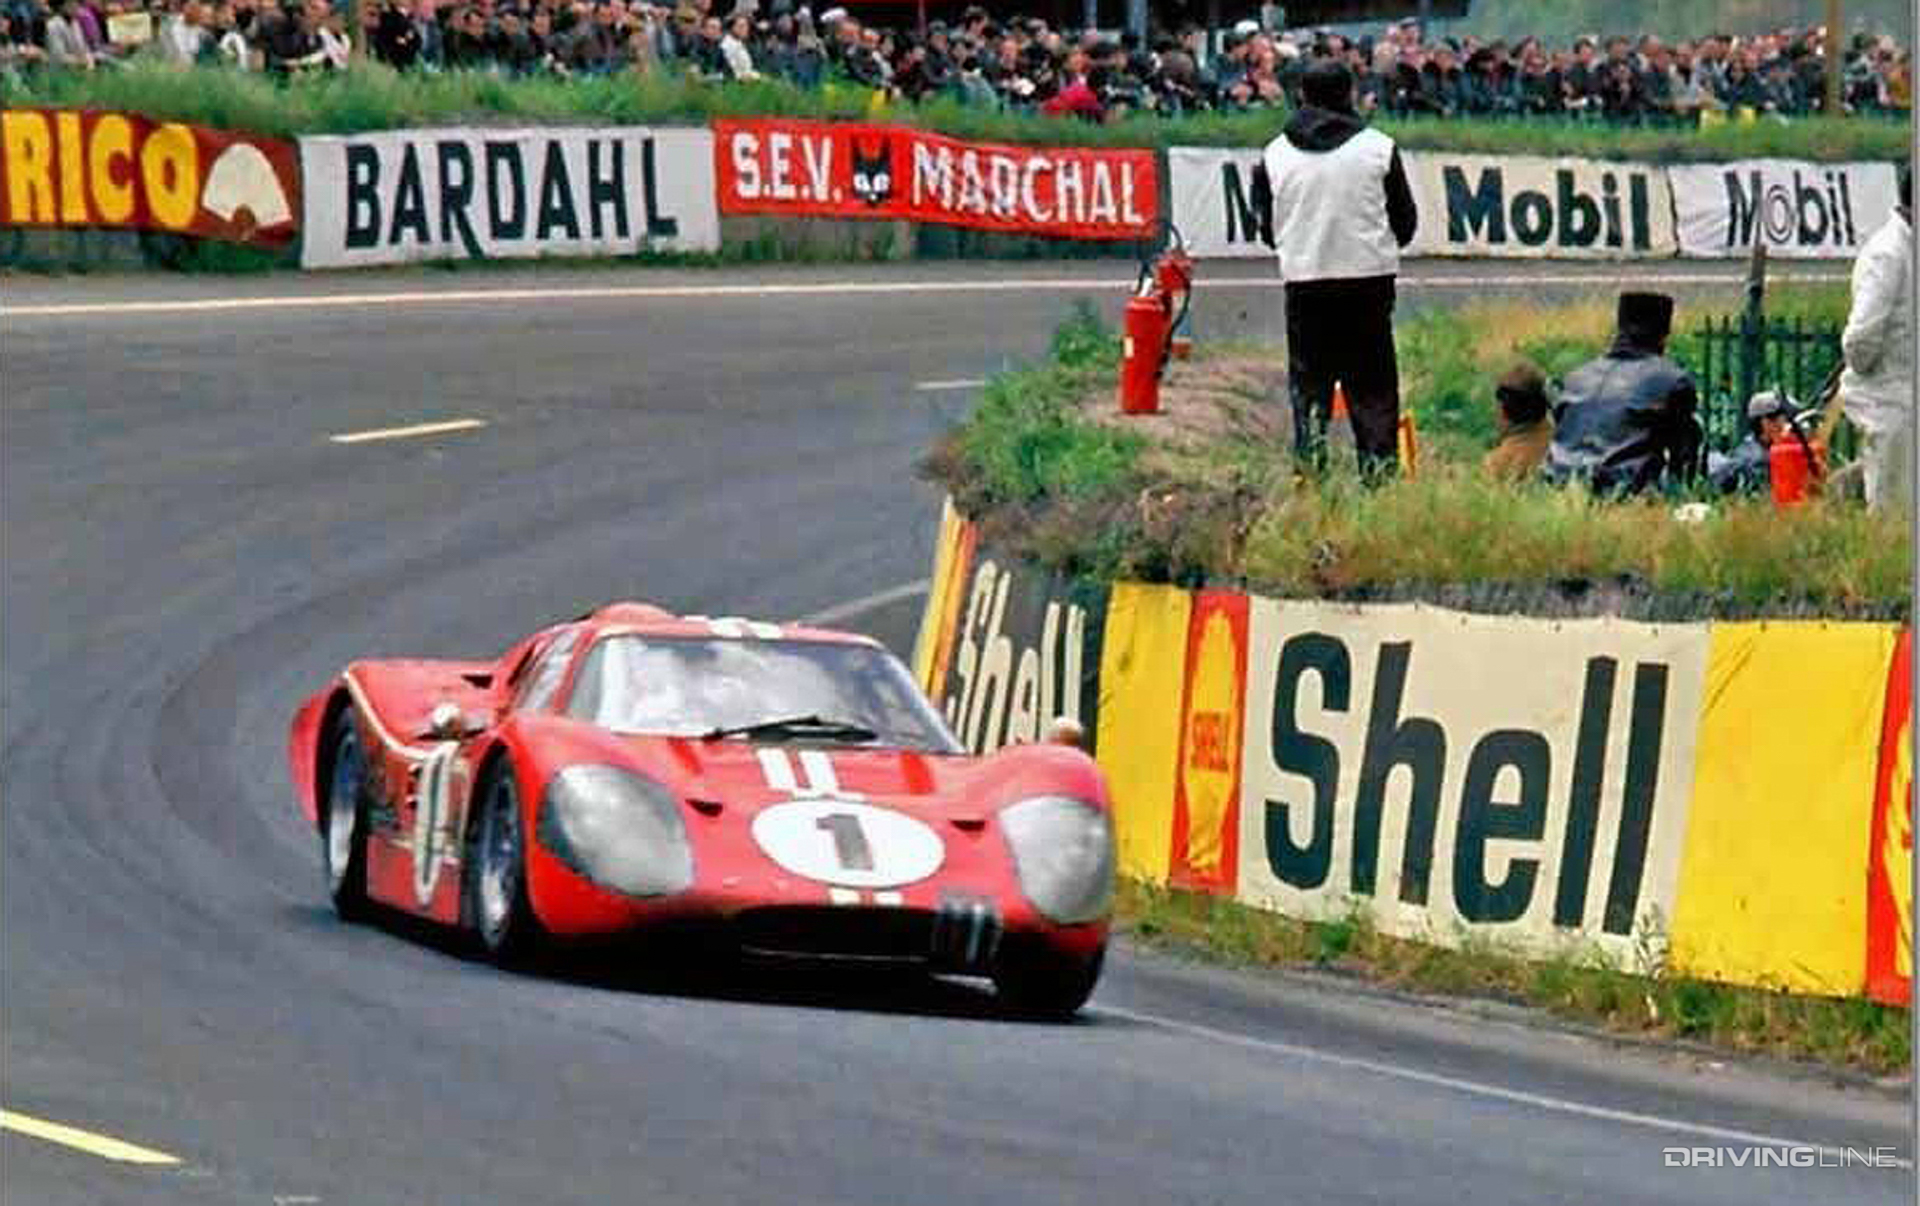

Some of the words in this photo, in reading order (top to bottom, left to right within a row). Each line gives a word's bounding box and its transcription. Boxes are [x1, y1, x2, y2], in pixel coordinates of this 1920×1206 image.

[345, 139, 679, 259] BARDAHL
[731, 132, 842, 202] S.E.V.
[912, 140, 1146, 225] MARCHAL
[1442, 164, 1651, 250] Mobil
[1724, 169, 1856, 247] Mobil
[946, 558, 1086, 757] Shell
[1263, 631, 1670, 937] Shell
[815, 813, 874, 871] 1
